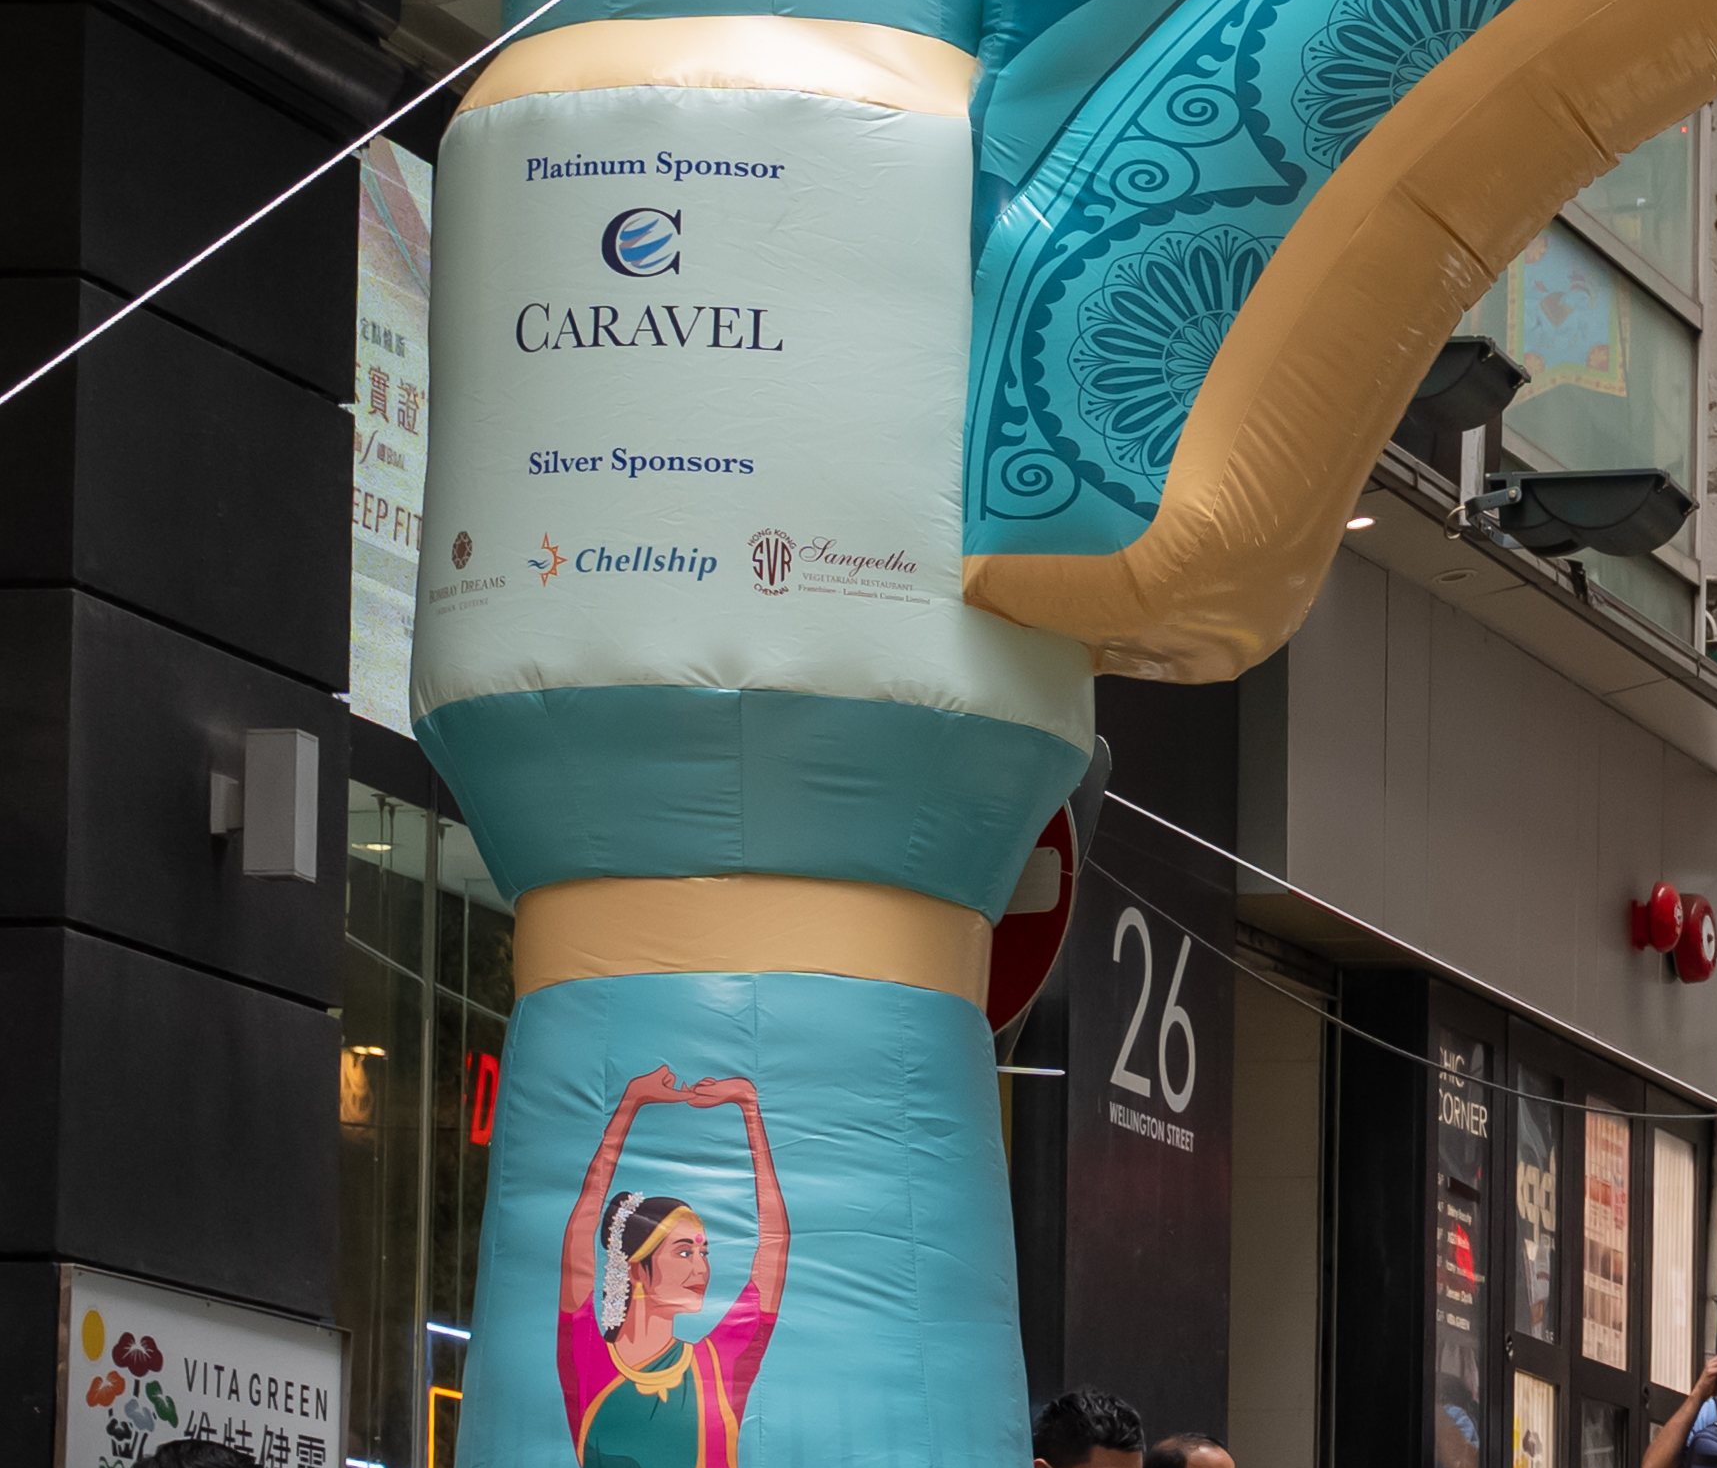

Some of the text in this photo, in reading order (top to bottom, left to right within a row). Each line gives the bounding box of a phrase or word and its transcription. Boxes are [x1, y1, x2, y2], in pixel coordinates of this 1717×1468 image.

[526, 150, 786, 181] Platinum Sponsor
[515, 302, 784, 353] CARAVEL
[528, 447, 755, 477] Silver Sponsors
[575, 545, 718, 581] Chellship
[798, 536, 918, 577] Sangeetha
[460, 575, 506, 597] DREAMS
[1110, 906, 1196, 1113] 26
[1109, 1101, 1194, 1153] WELLINGTON STREET
